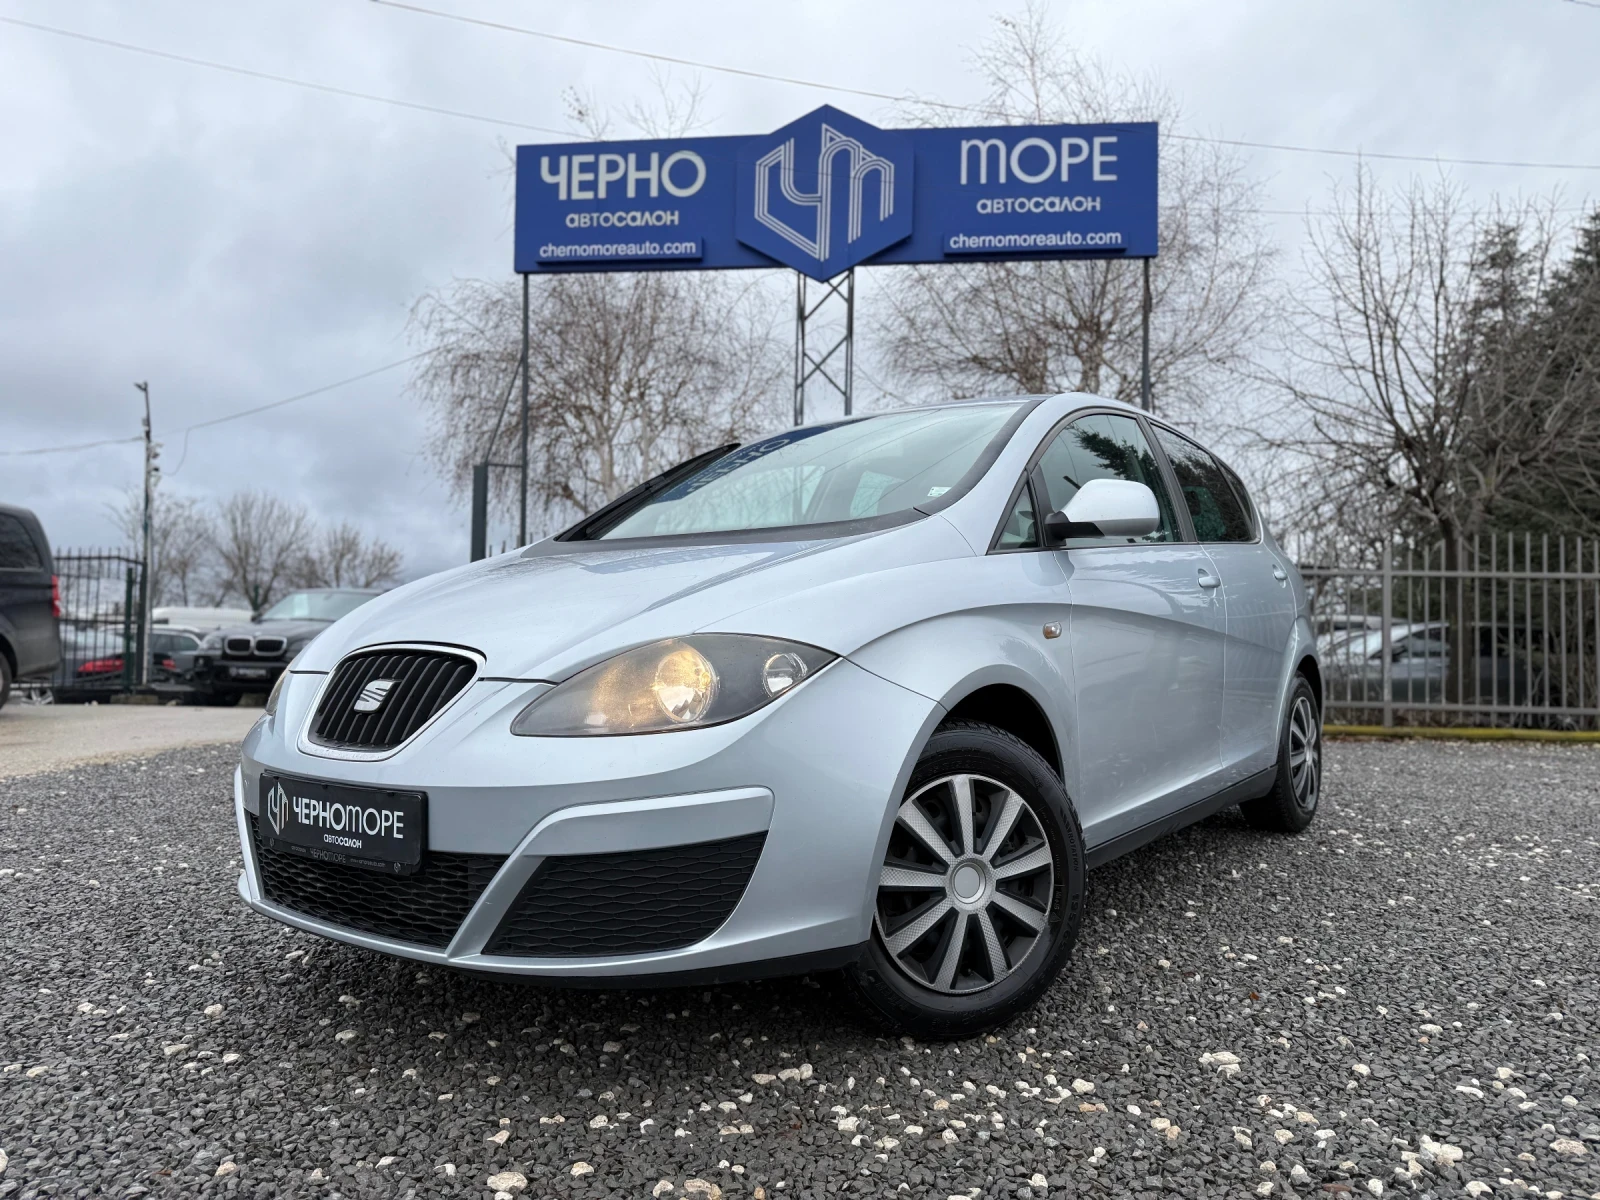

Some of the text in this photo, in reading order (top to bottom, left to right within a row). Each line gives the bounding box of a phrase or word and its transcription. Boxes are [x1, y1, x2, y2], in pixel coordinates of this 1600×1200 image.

[960, 136, 1118, 185] МОРЕ
[540, 150, 707, 201] ЧЕРНО
[976, 196, 1101, 214] автосалон
[565, 210, 679, 228] автосалон
[539, 240, 697, 258] chernomoreauto.com
[949, 231, 1122, 249] chernomoreauto.com
[293, 796, 404, 839] ЧЕРНОМОРЕ
[323, 833, 362, 849] автосалон
